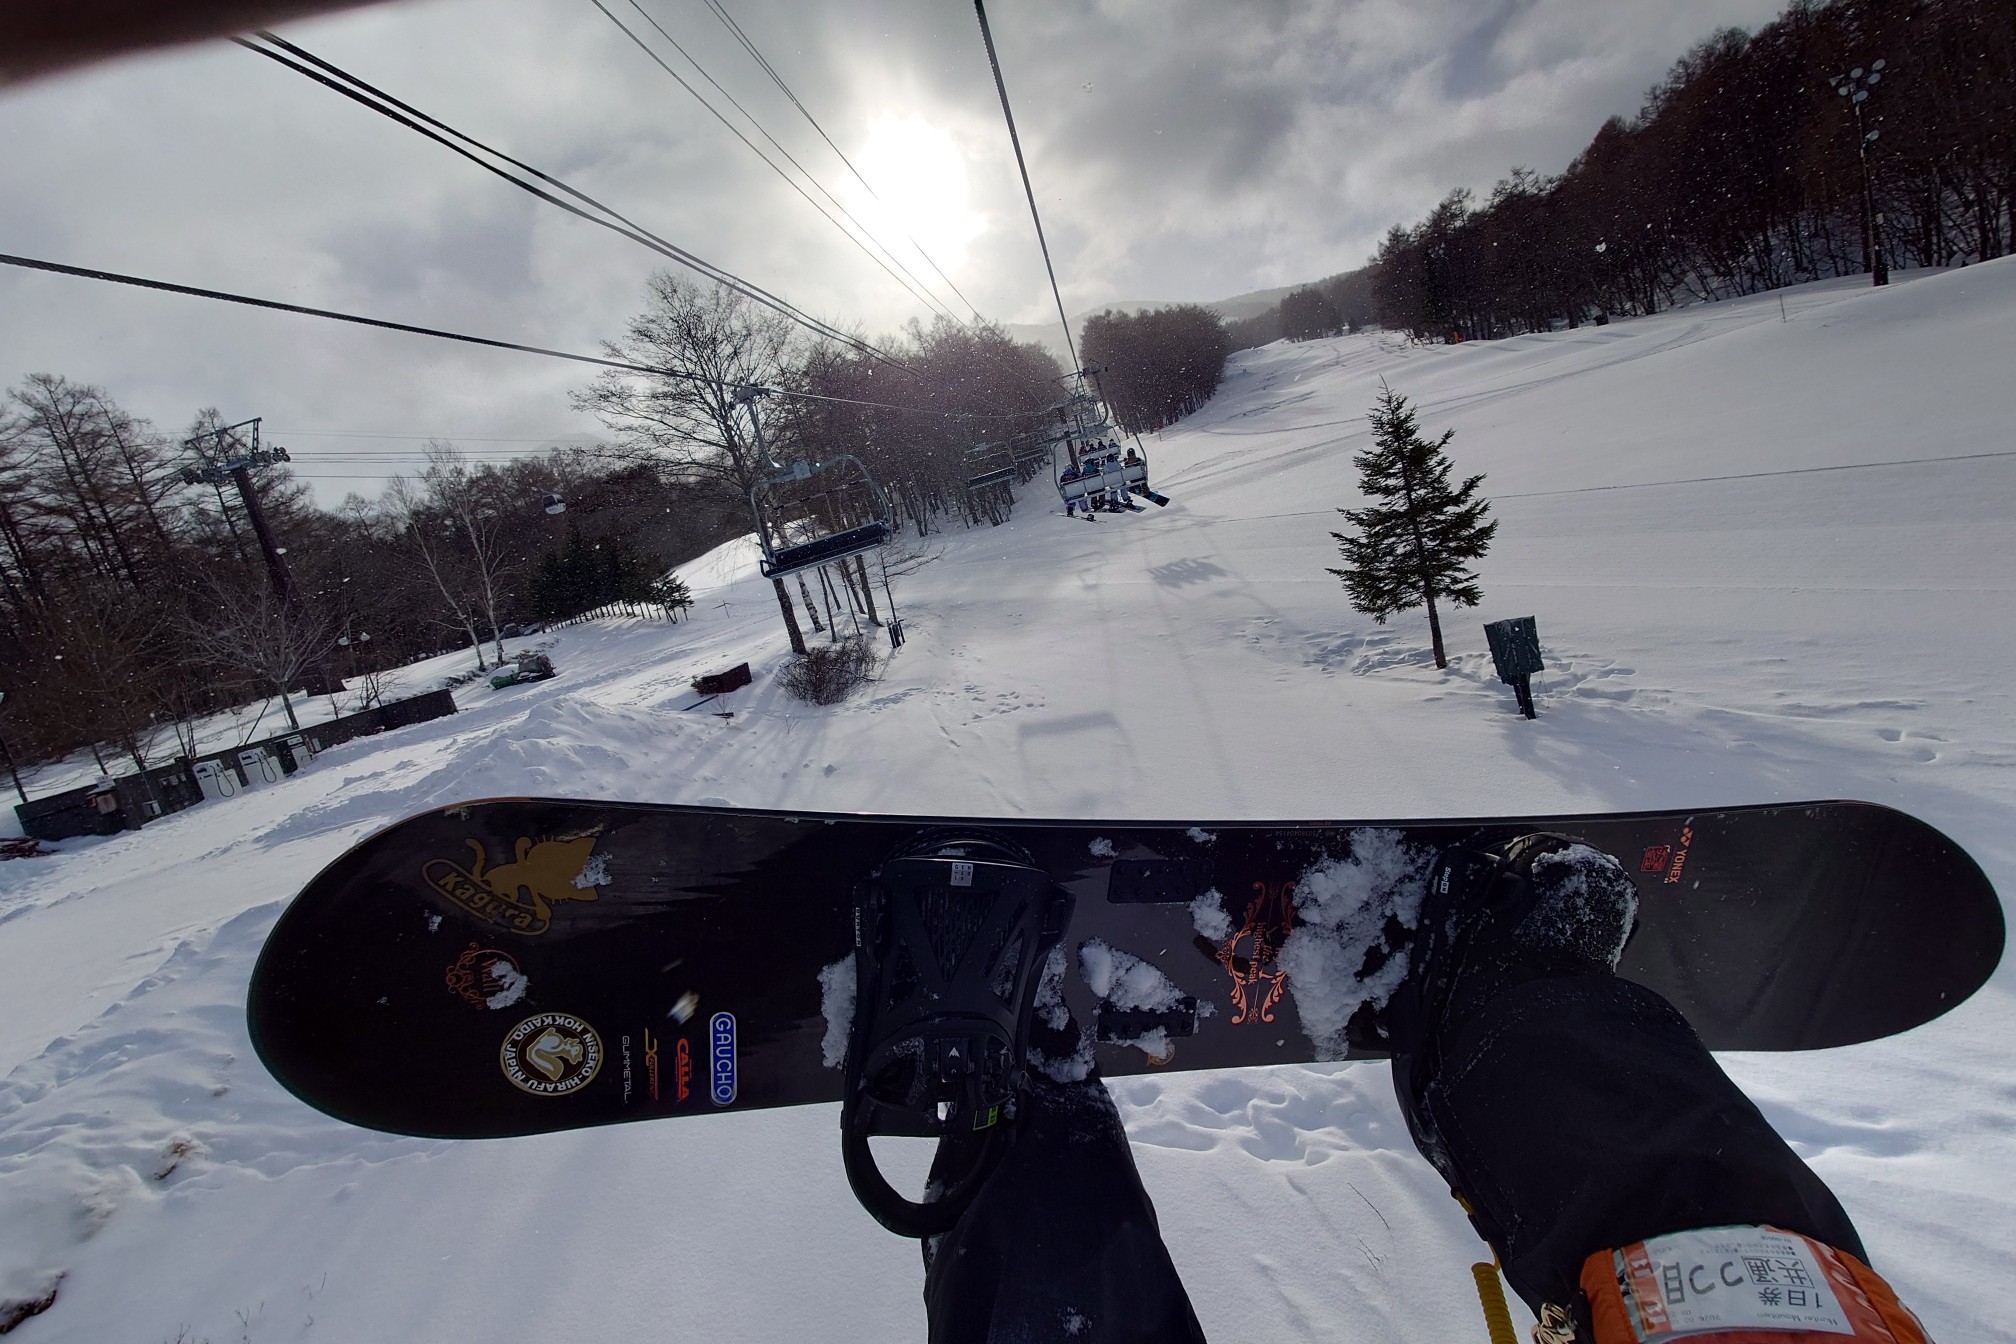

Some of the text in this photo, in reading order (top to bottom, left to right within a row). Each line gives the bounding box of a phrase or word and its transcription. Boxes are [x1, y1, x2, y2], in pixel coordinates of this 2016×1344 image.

[1668, 849, 1688, 884] YONEX
[438, 872, 533, 929] Kagura
[1248, 922, 1266, 985] highest peak
[505, 1015, 585, 1082] HOKKAIDO JAPAN
[677, 1038, 690, 1099] CALLA
[716, 1017, 733, 1098] GAUCHO
[1743, 1257, 1807, 1285] 共通
[1758, 1287, 1823, 1309] 1日券
[1756, 1313, 1838, 1326] Hunter Mountain
